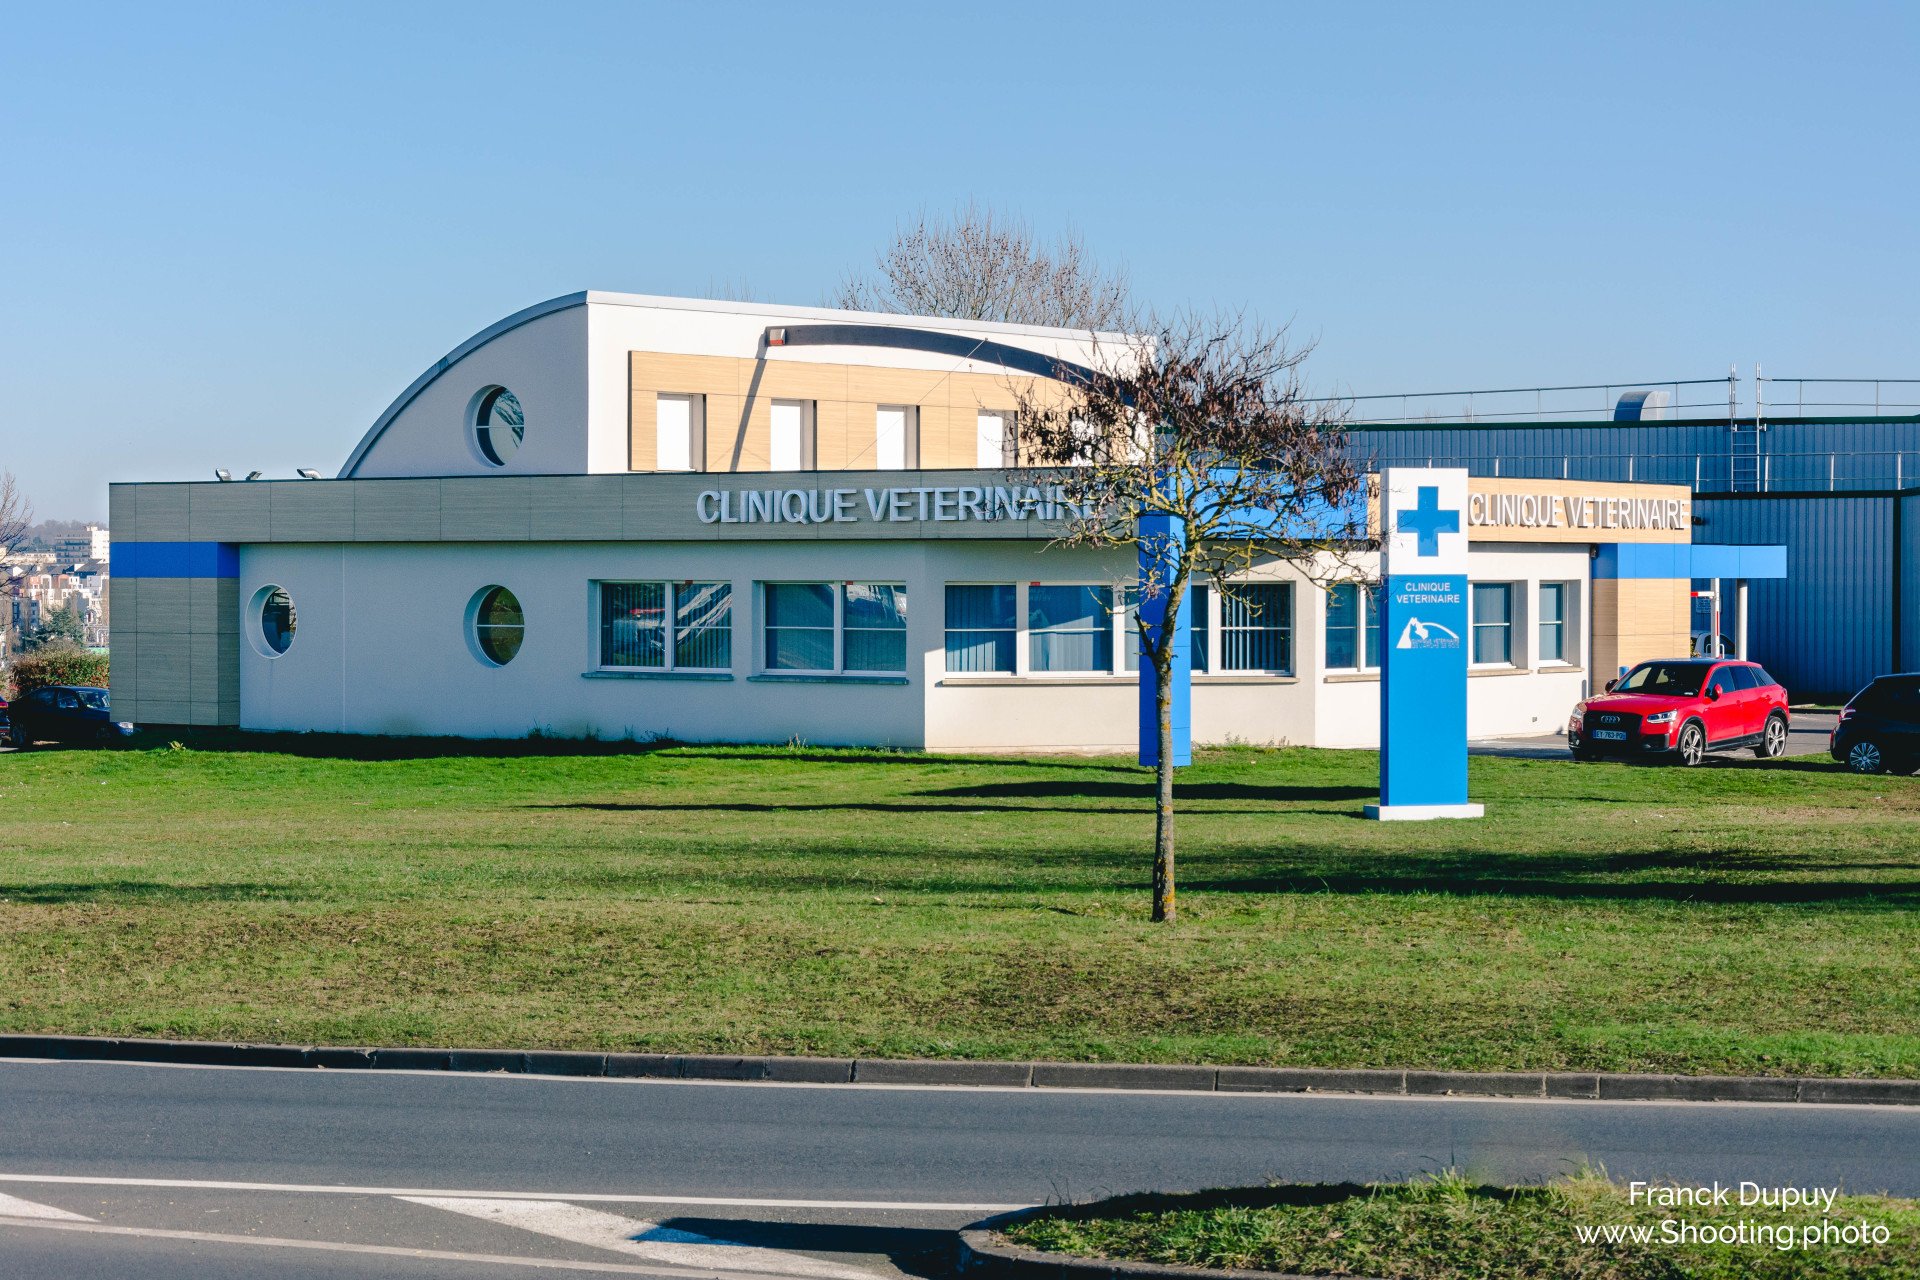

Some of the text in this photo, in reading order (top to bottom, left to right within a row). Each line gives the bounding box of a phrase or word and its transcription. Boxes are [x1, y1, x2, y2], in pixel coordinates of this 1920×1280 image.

[697, 488, 858, 525] CLINIQUE
[1468, 493, 1691, 530] CLINIQUE VETERINAIRE
[1405, 582, 1451, 592] CLINIQUE
[1396, 594, 1460, 604] VETERINAIRE
